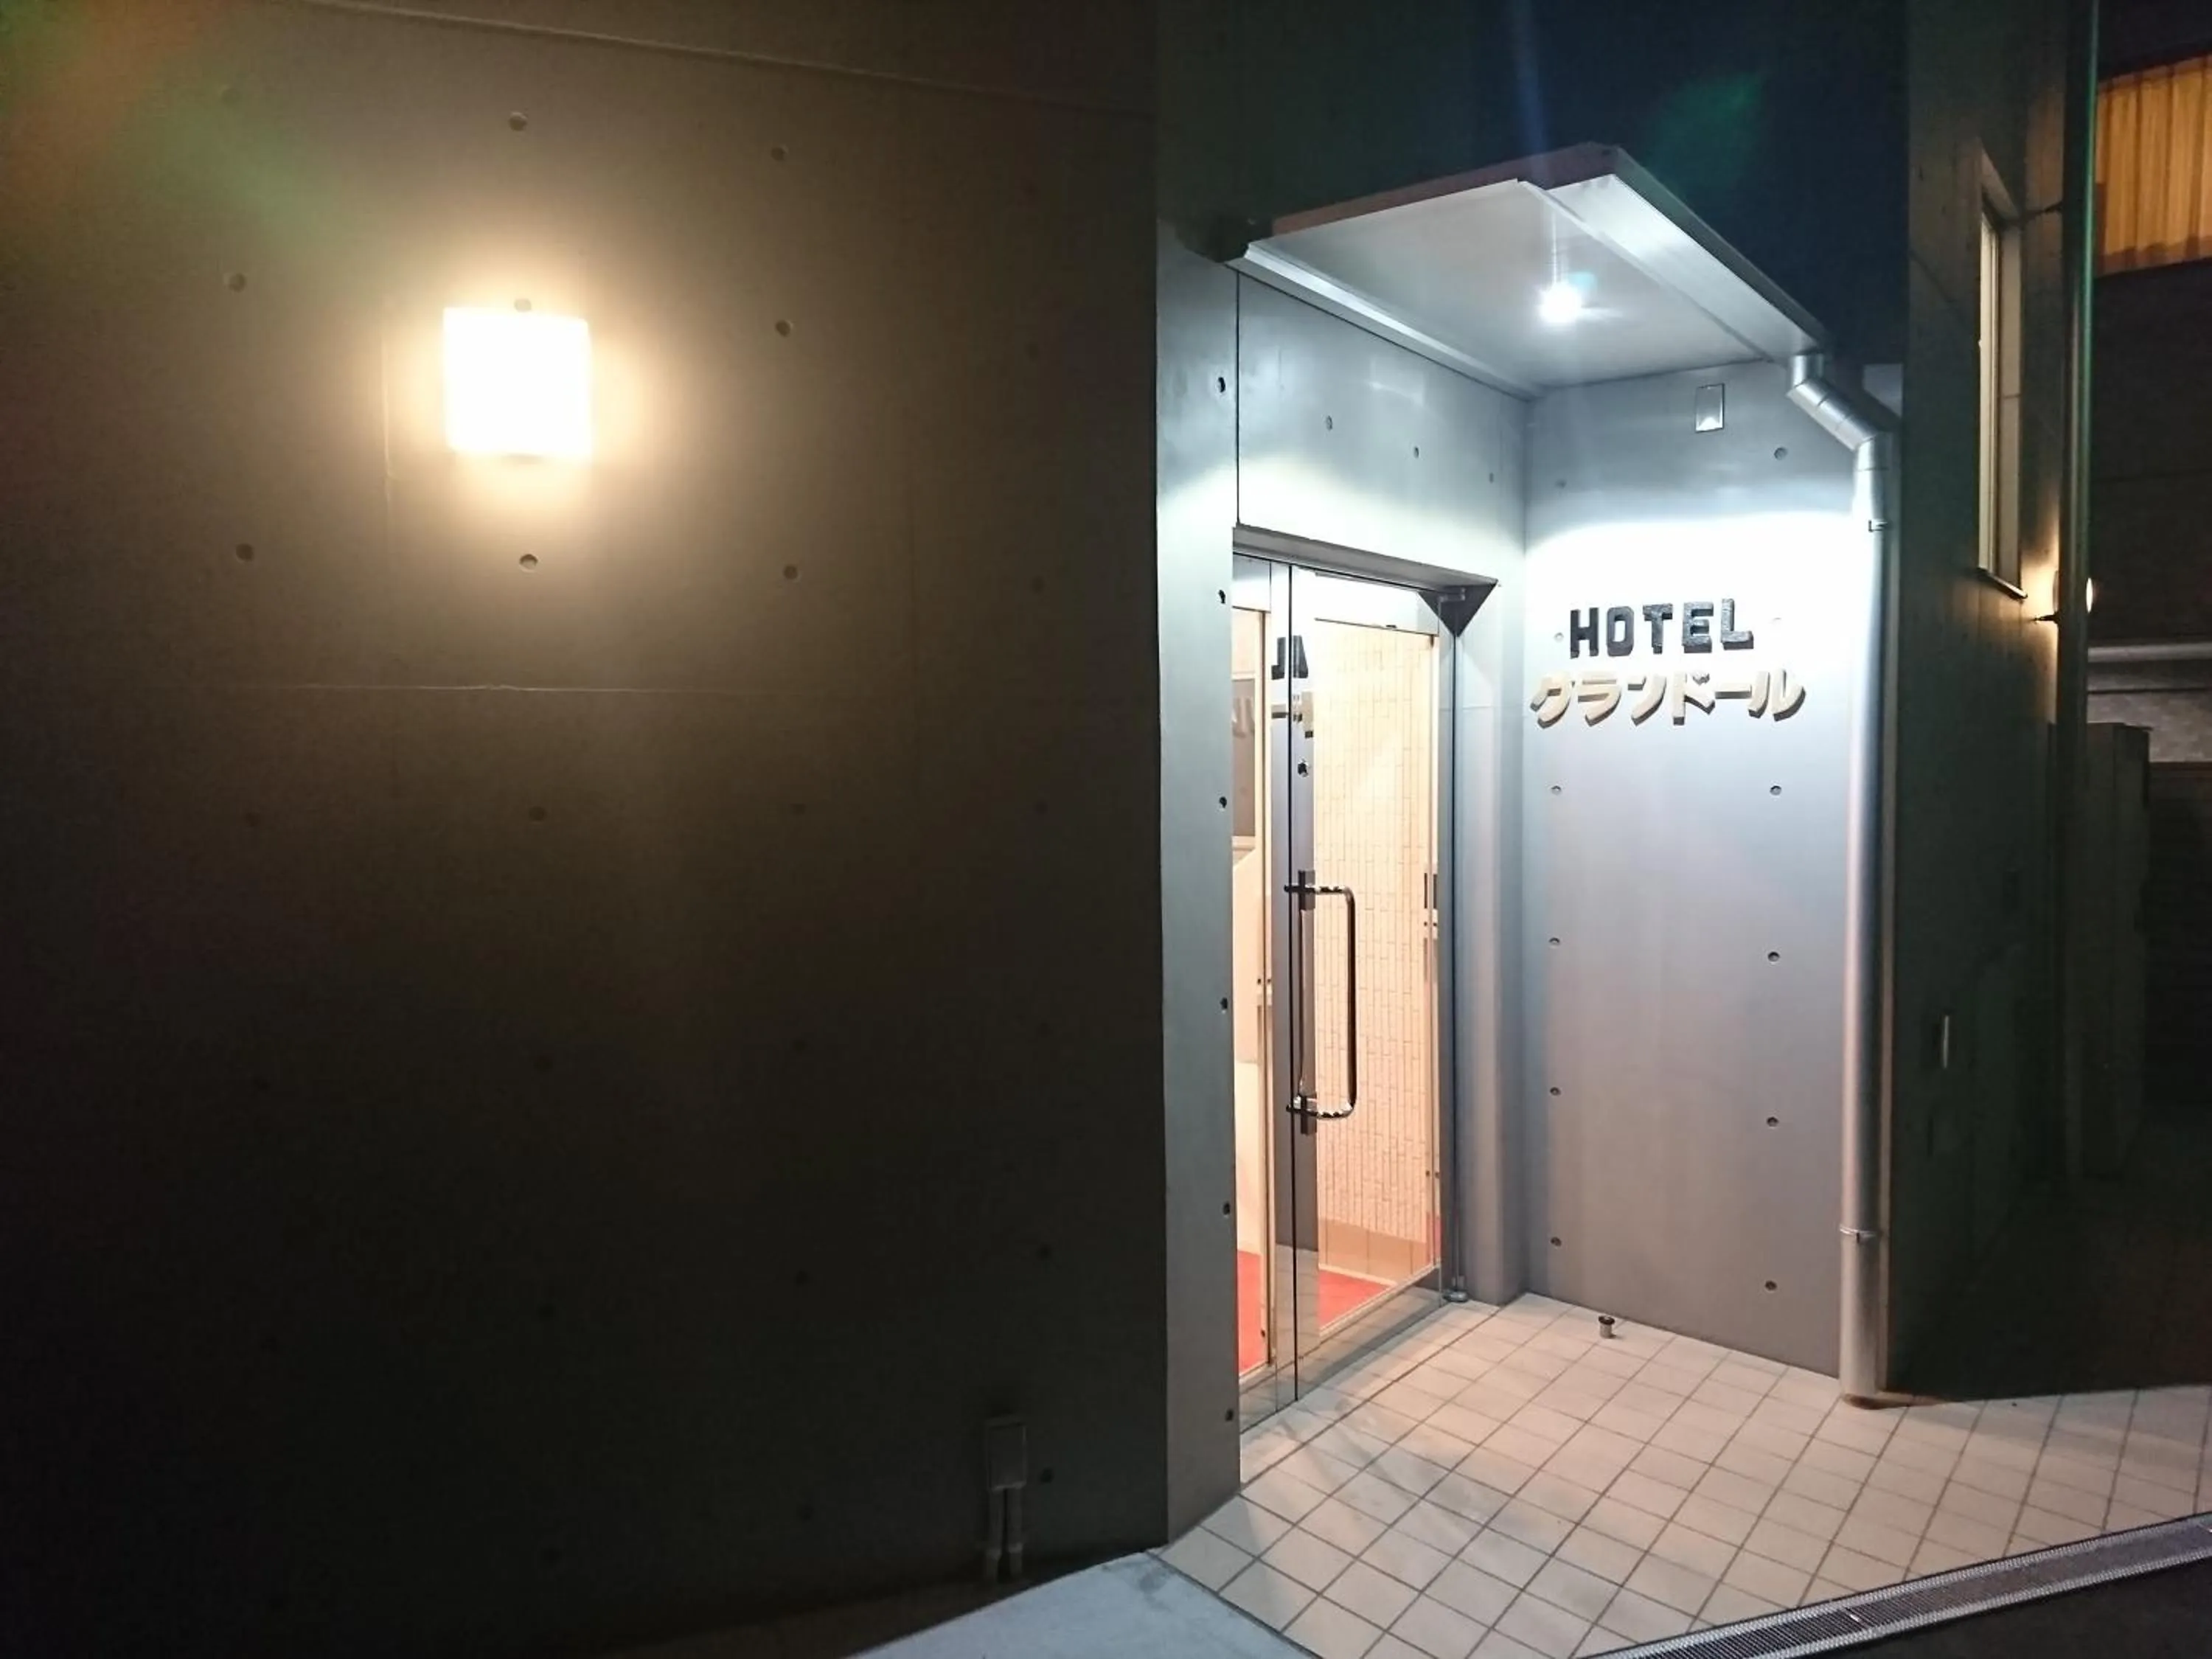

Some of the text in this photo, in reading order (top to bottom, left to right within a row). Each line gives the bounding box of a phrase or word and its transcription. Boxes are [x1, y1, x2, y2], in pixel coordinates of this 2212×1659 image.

[1570, 598, 1754, 659] HOTEL
[1530, 669, 1806, 728] グランドール
